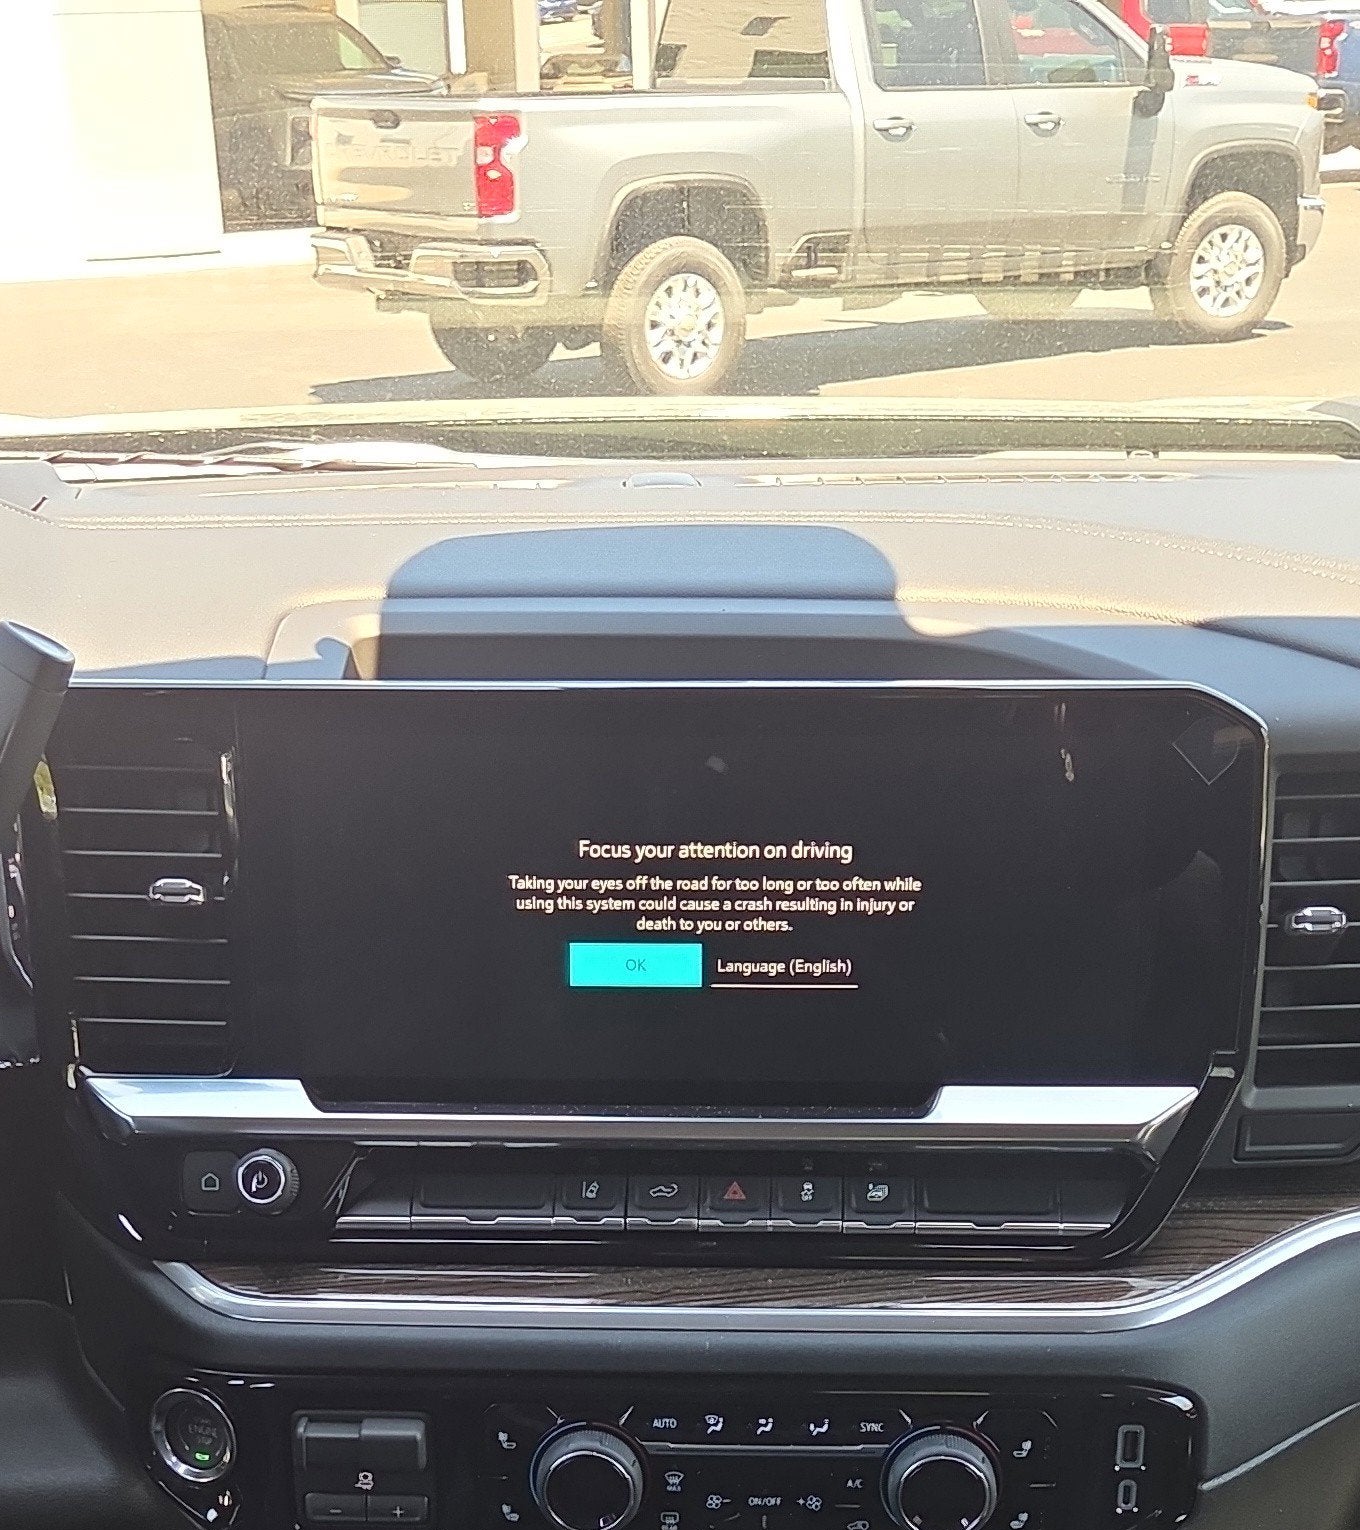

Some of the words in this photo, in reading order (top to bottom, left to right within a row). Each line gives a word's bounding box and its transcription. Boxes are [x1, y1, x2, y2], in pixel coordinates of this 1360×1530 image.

[578, 840, 631, 858] Focus
[634, 844, 675, 863] your
[679, 841, 761, 858] attention
[764, 845, 788, 858] on
[791, 841, 853, 863] driving
[508, 875, 555, 893] Taking
[557, 879, 588, 893] your
[591, 879, 623, 894] eyes
[625, 875, 648, 891] off
[650, 876, 673, 890] the
[676, 876, 708, 891] road
[711, 876, 735, 891] for
[735, 877, 759, 891] too
[762, 877, 794, 894] long
[797, 880, 812, 891] or
[815, 877, 839, 891] too
[842, 877, 881, 891] often
[884, 877, 922, 891] while
[516, 897, 554, 912] using
[557, 896, 583, 911] this
[585, 899, 636, 914] system
[638, 897, 677, 911] could
[679, 900, 720, 911] cause
[722, 900, 732, 911] a
[734, 897, 773, 911] crash
[775, 897, 837, 914] resulting
[840, 897, 854, 911] in
[856, 897, 896, 915] injury
[899, 900, 915, 912] or
[636, 917, 676, 931] death
[679, 918, 693, 931] to
[696, 920, 722, 934] you
[725, 920, 740, 931] or
[743, 917, 793, 931] others.
[625, 959, 647, 972] OK
[717, 959, 785, 976] Language
[789, 959, 851, 977] (English)
[652, 1418, 678, 1429] AUTO
[860, 1422, 884, 1432] SYNC
[847, 1479, 864, 1489] A/C
[748, 1497, 781, 1506] ON/OFF
